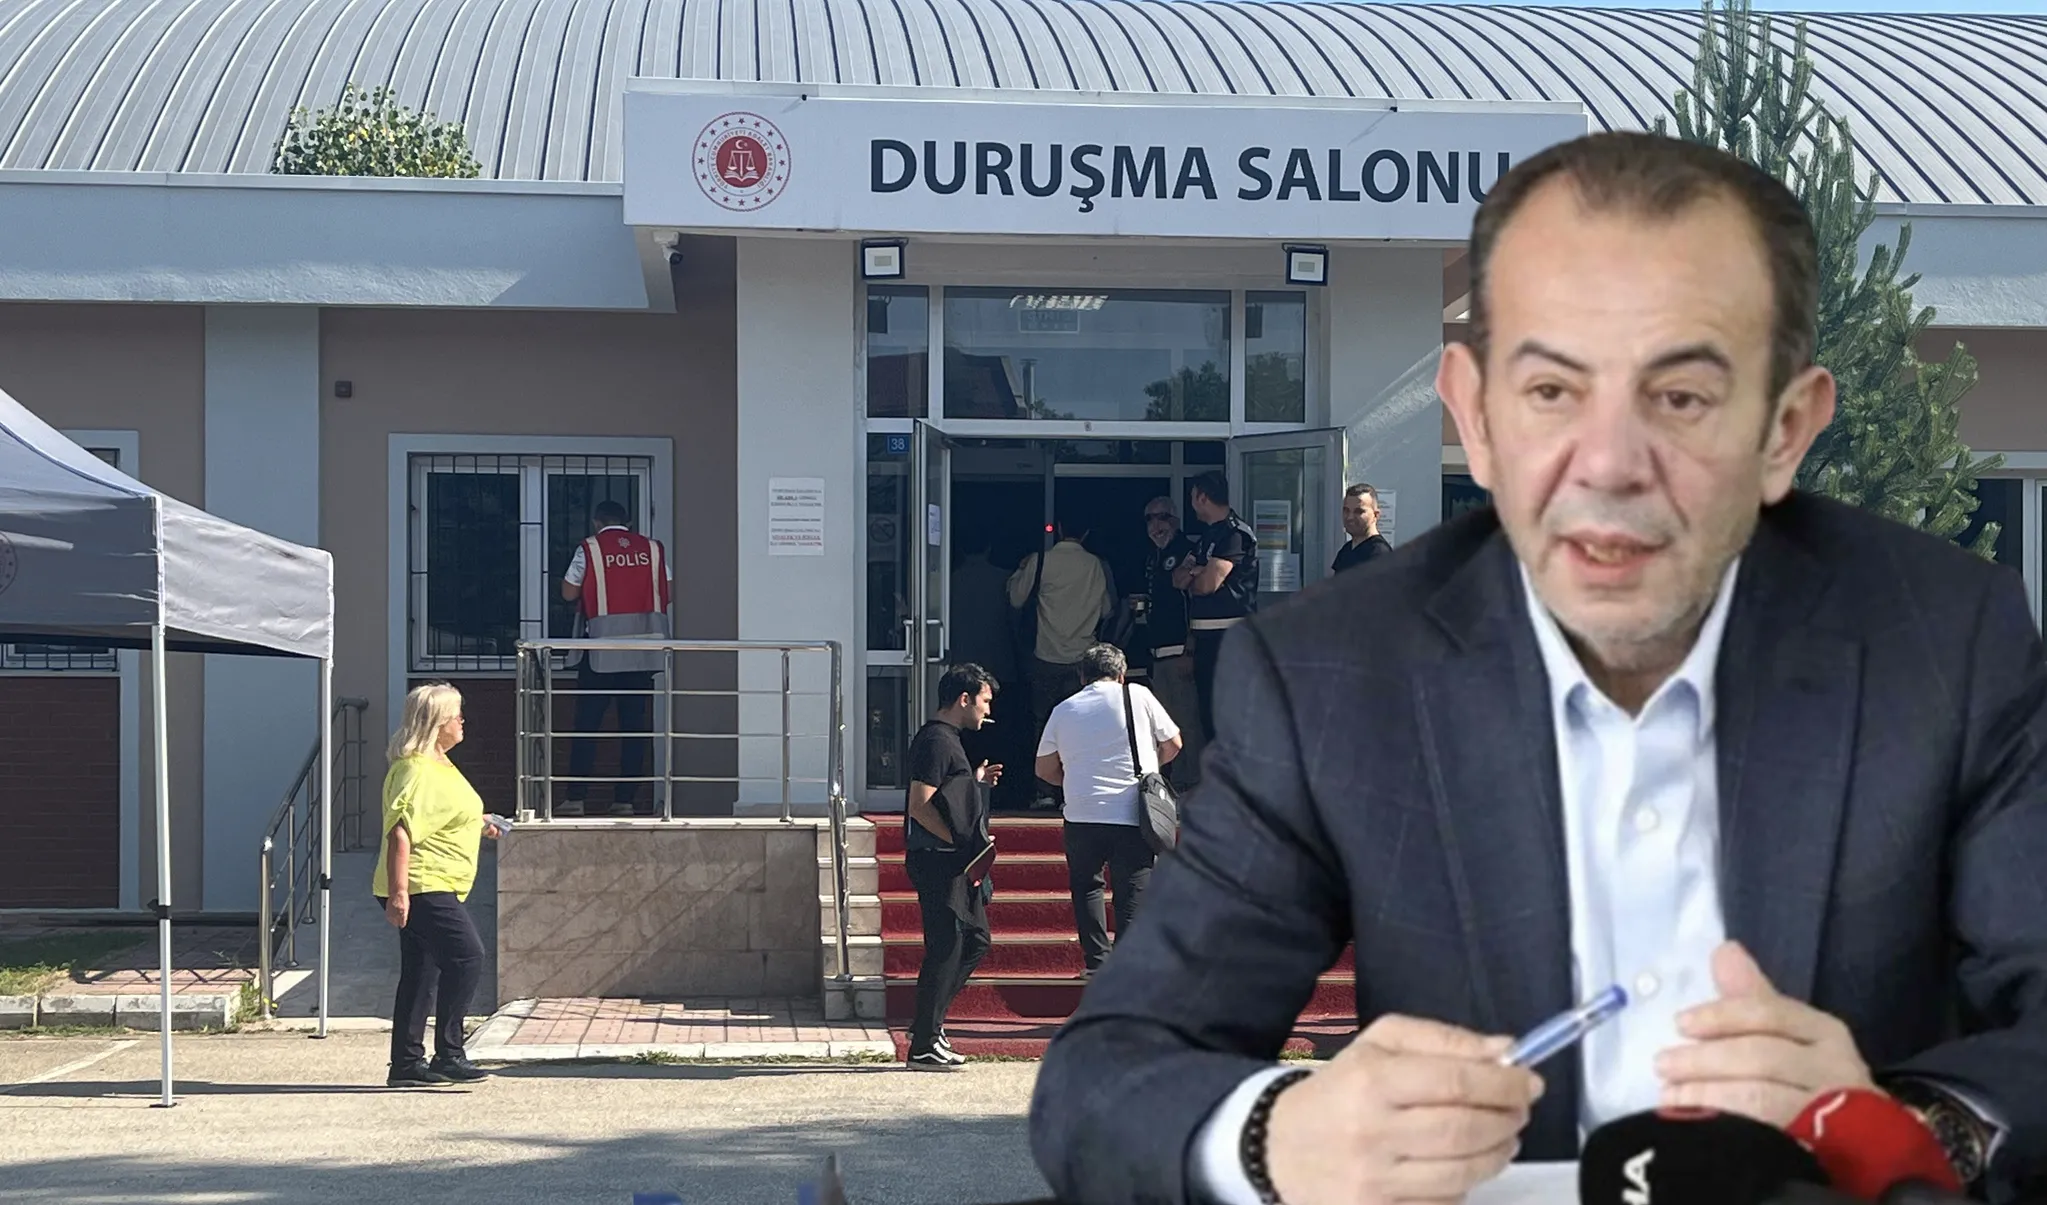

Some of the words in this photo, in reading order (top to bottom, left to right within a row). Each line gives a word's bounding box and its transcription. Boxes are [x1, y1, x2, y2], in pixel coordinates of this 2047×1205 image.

[870, 138, 1219, 213] DURUŞMA
[1237, 146, 1510, 205] SALONU
[891, 437, 905, 450] 38
